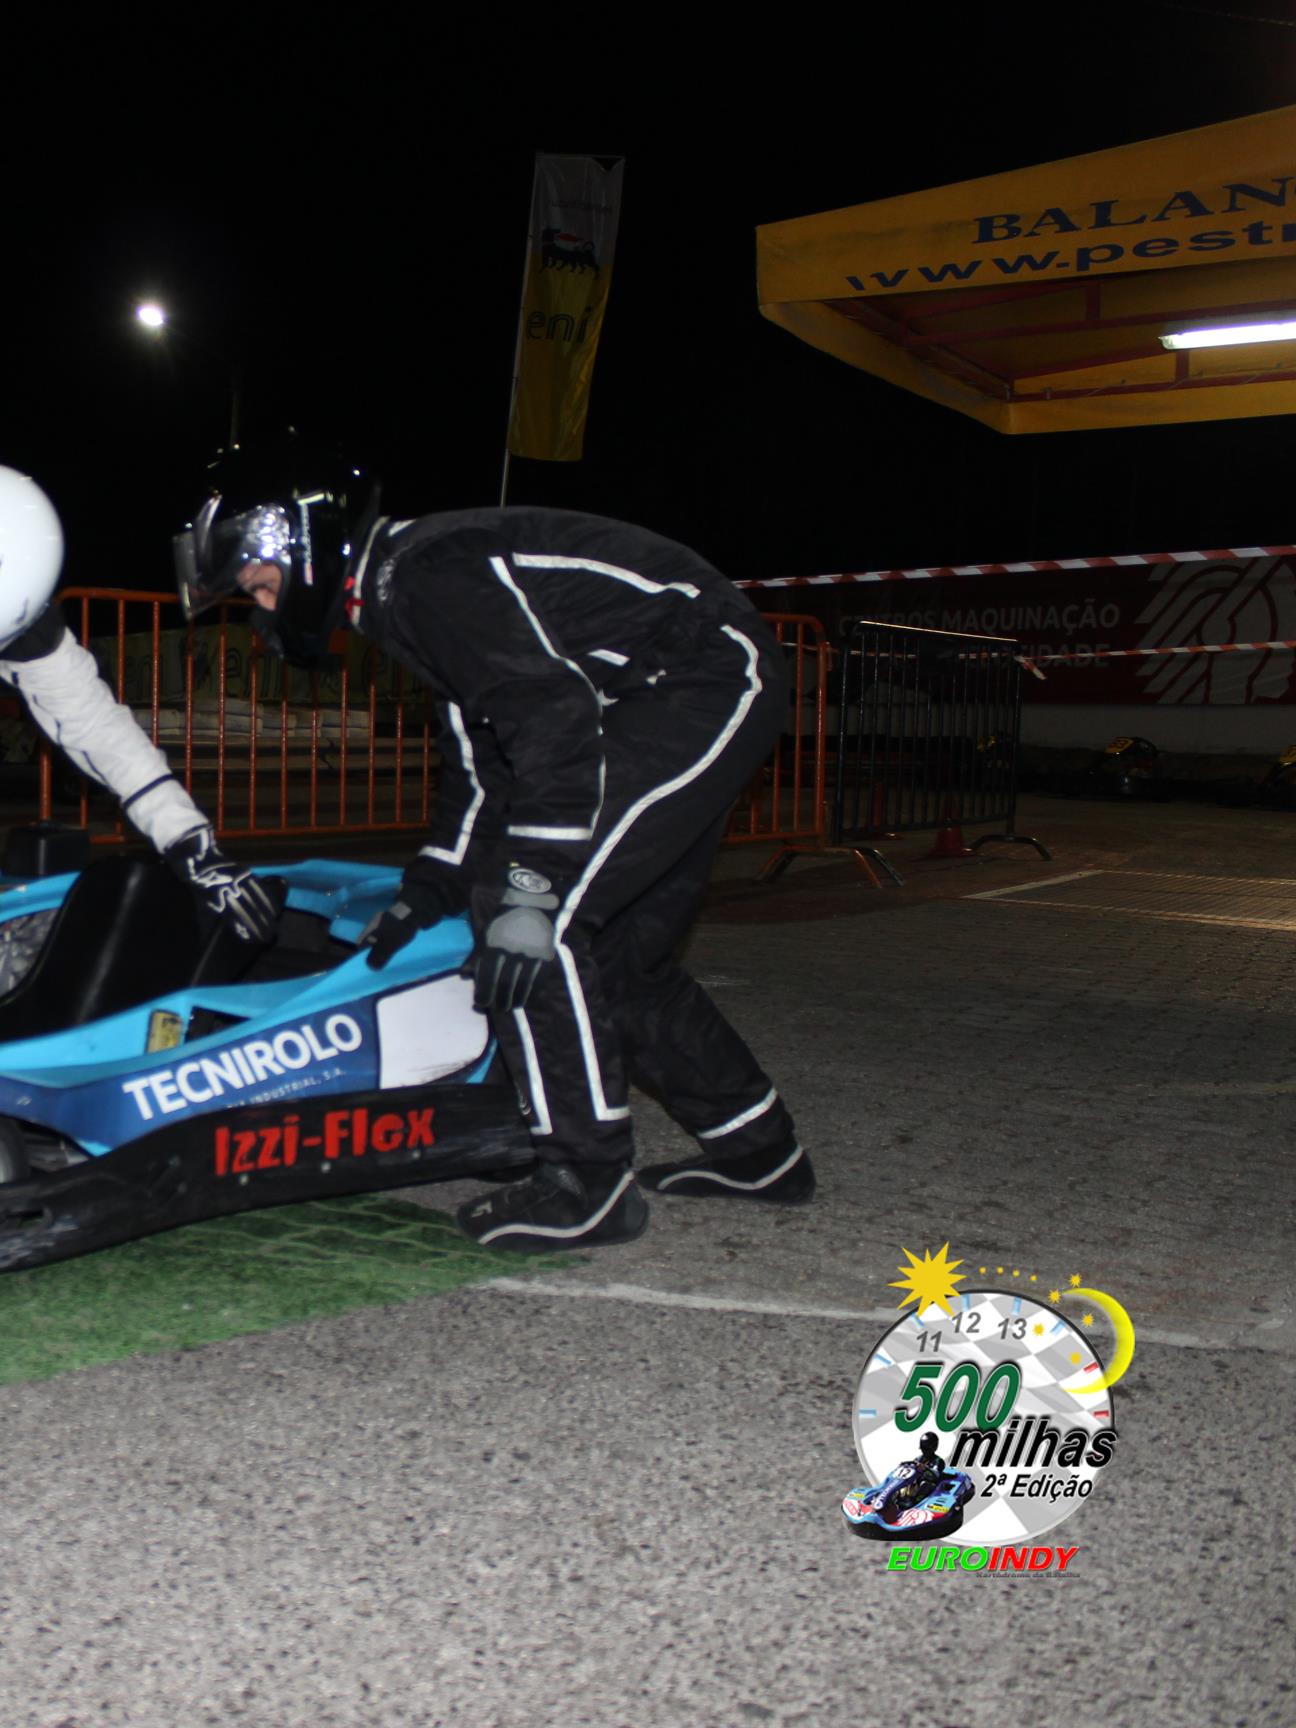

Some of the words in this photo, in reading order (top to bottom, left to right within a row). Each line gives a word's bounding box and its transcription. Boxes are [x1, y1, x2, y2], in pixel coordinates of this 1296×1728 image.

[971, 174, 1296, 244] BALAN
[526, 306, 594, 343] eni
[942, 598, 1120, 635] MAQUINAÇÃO
[122, 1013, 363, 1121] TECNIROLO
[214, 1107, 436, 1177] Izzi-Flex
